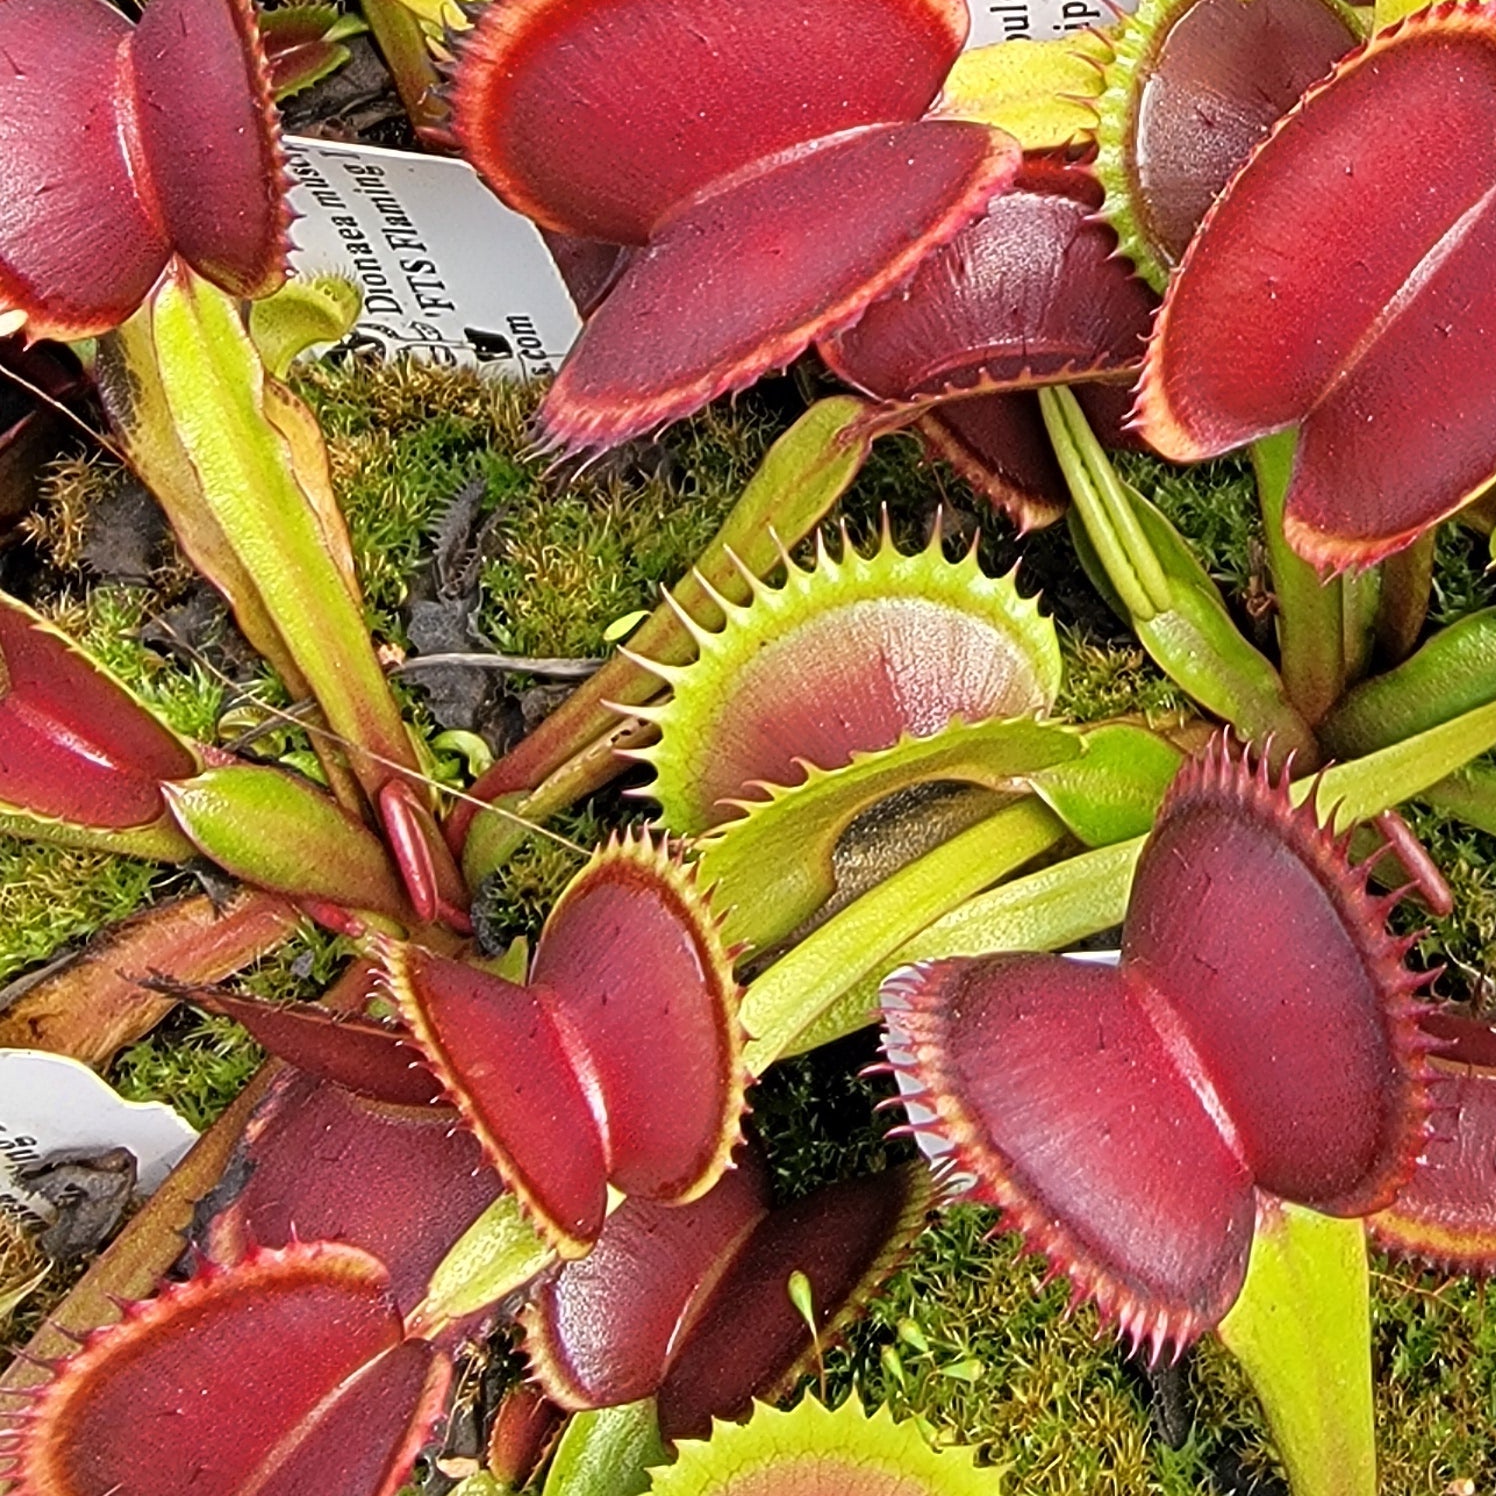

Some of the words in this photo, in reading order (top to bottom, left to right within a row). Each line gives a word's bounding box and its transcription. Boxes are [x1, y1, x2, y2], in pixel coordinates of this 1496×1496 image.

[343, 162, 428, 253] Flaming
[331, 214, 404, 316] Dionaea
[399, 258, 456, 317] 'FTS
